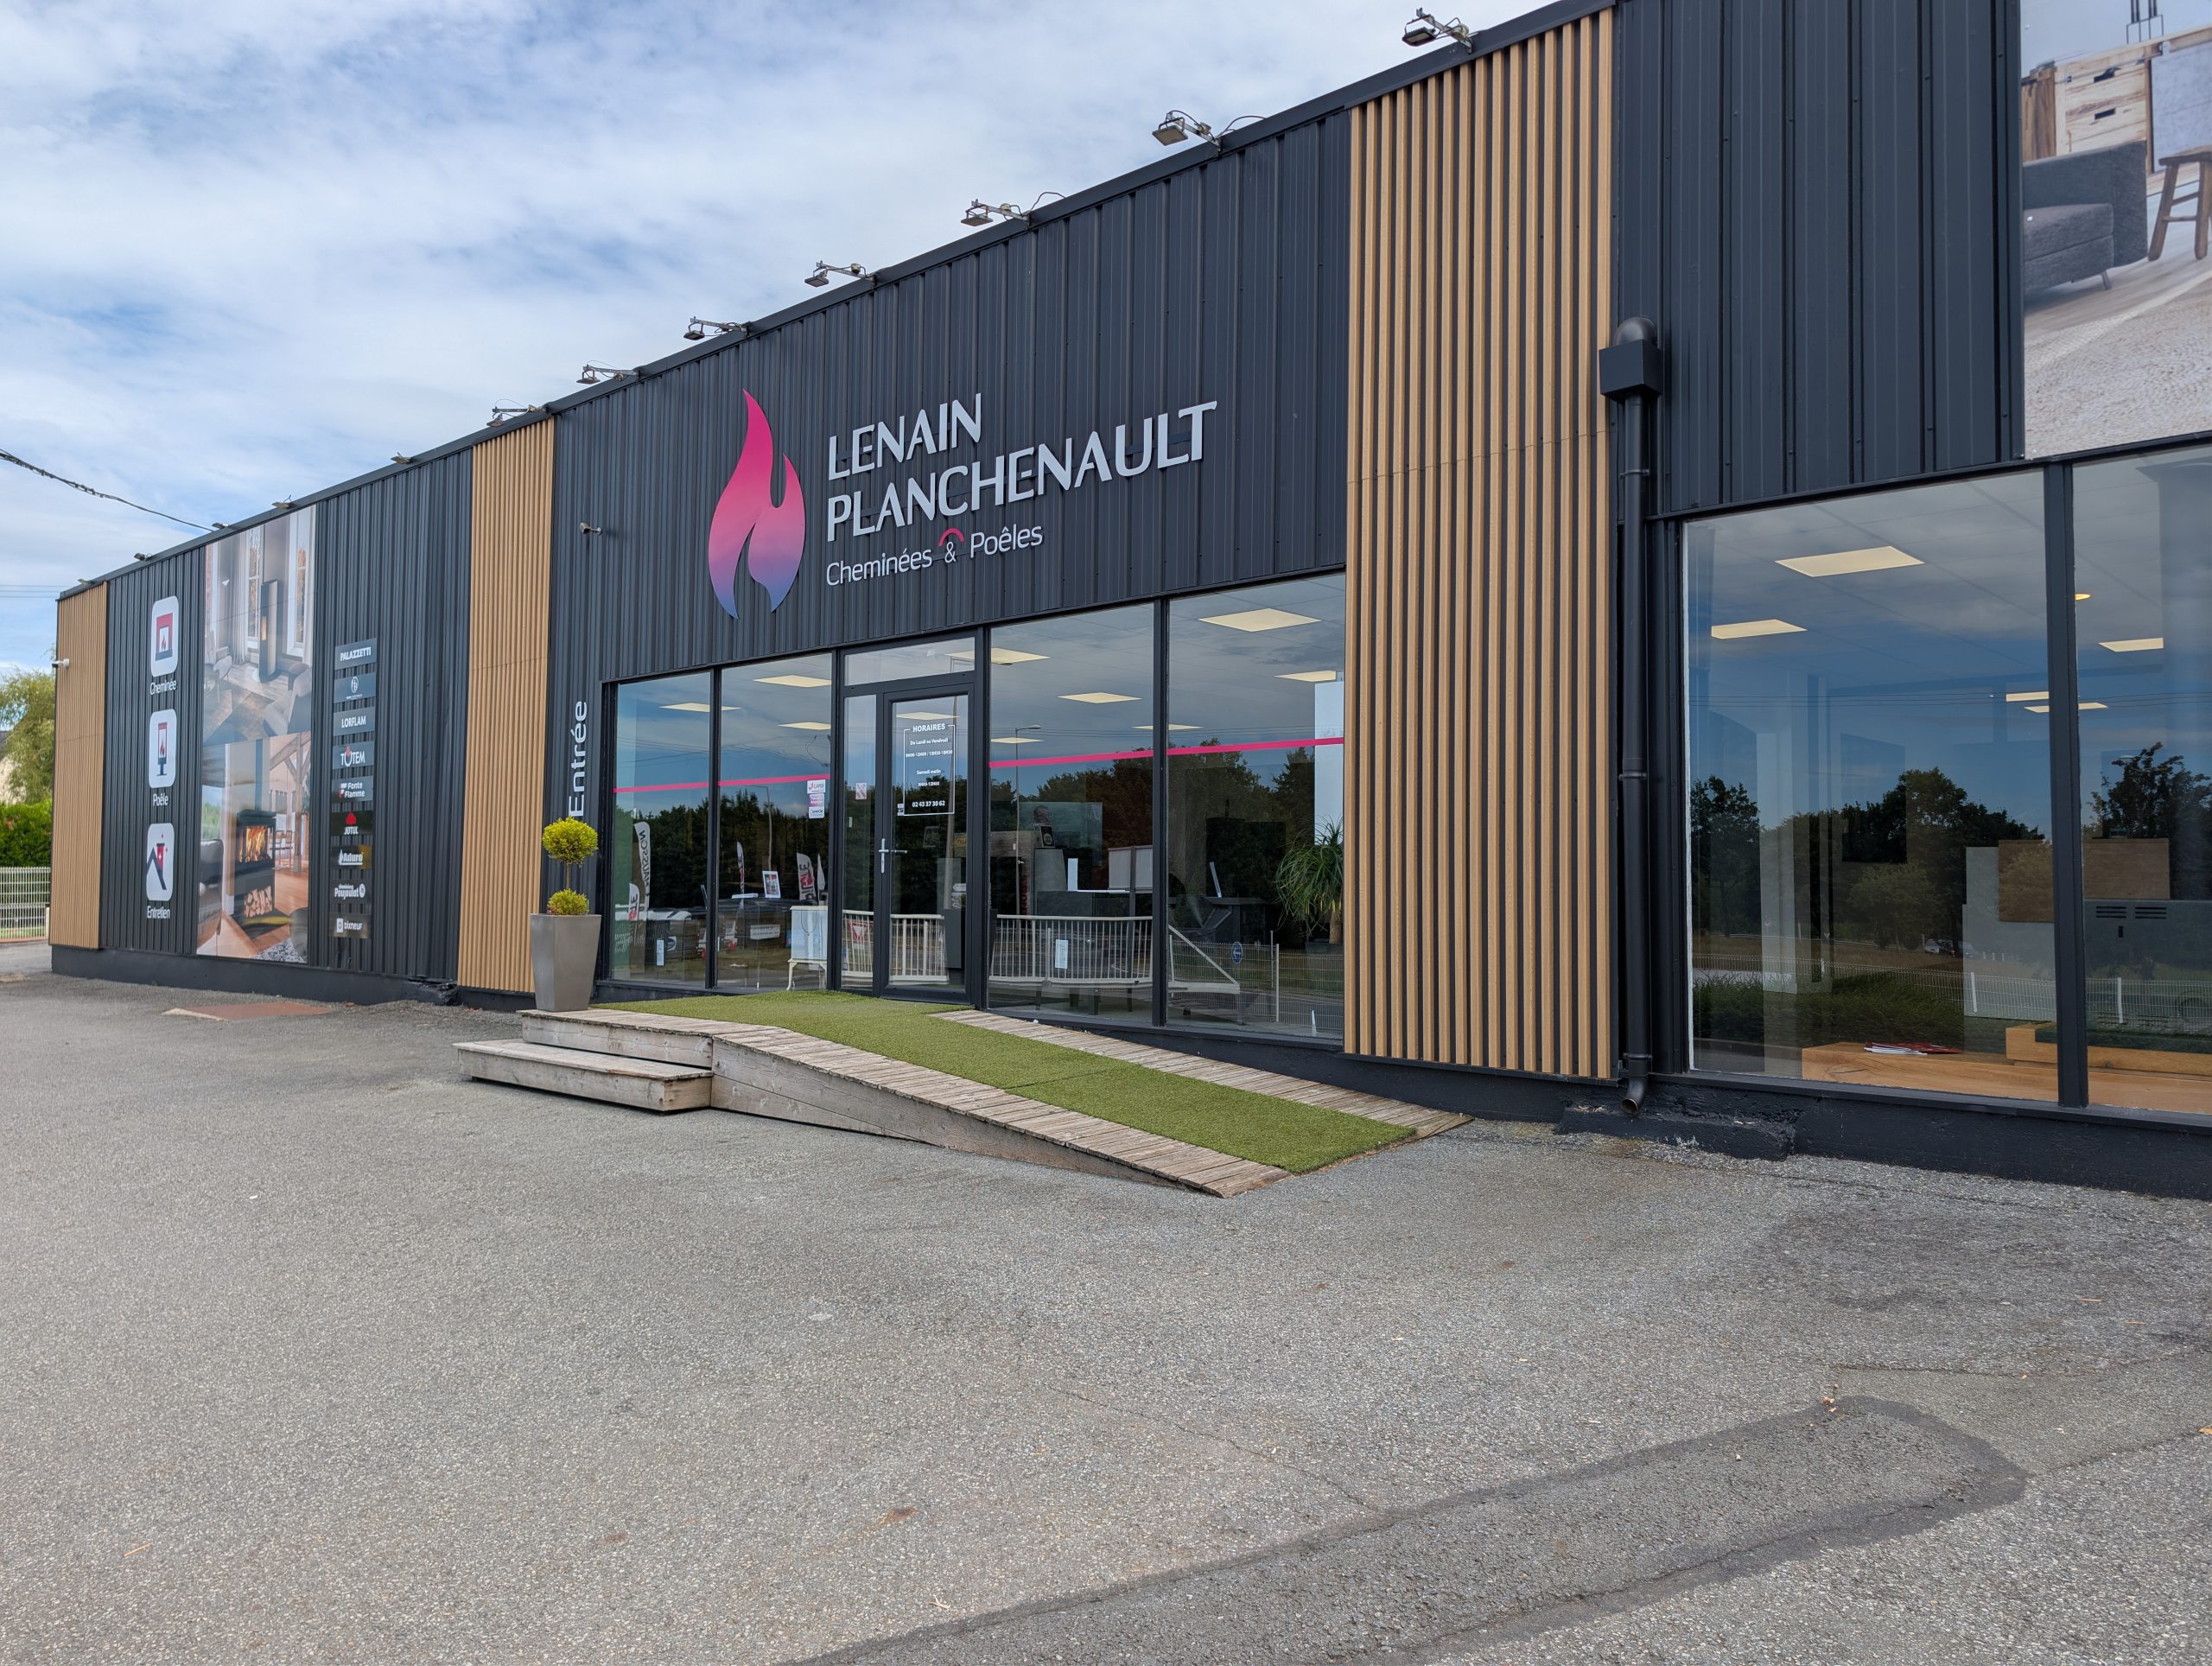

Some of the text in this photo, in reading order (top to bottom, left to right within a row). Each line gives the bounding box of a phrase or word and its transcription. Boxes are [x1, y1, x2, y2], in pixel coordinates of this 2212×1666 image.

[828, 392, 982, 480] LENAIN
[827, 400, 1217, 542] PLANCHENAULT
[826, 525, 1044, 587] Cheminées & Poêles
[340, 646, 372, 662] PALAZZETTI
[149, 678, 177, 695] Cheminée
[341, 715, 366, 728] LORFLAM
[912, 723, 946, 733] HORAIRES
[340, 747, 365, 767] TOTEM
[568, 701, 588, 817] Entrée
[153, 792, 169, 807] Poêle
[342, 851, 363, 862] Aduro
[334, 887, 359, 900] Poujoulat
[147, 905, 171, 919] Entretien
